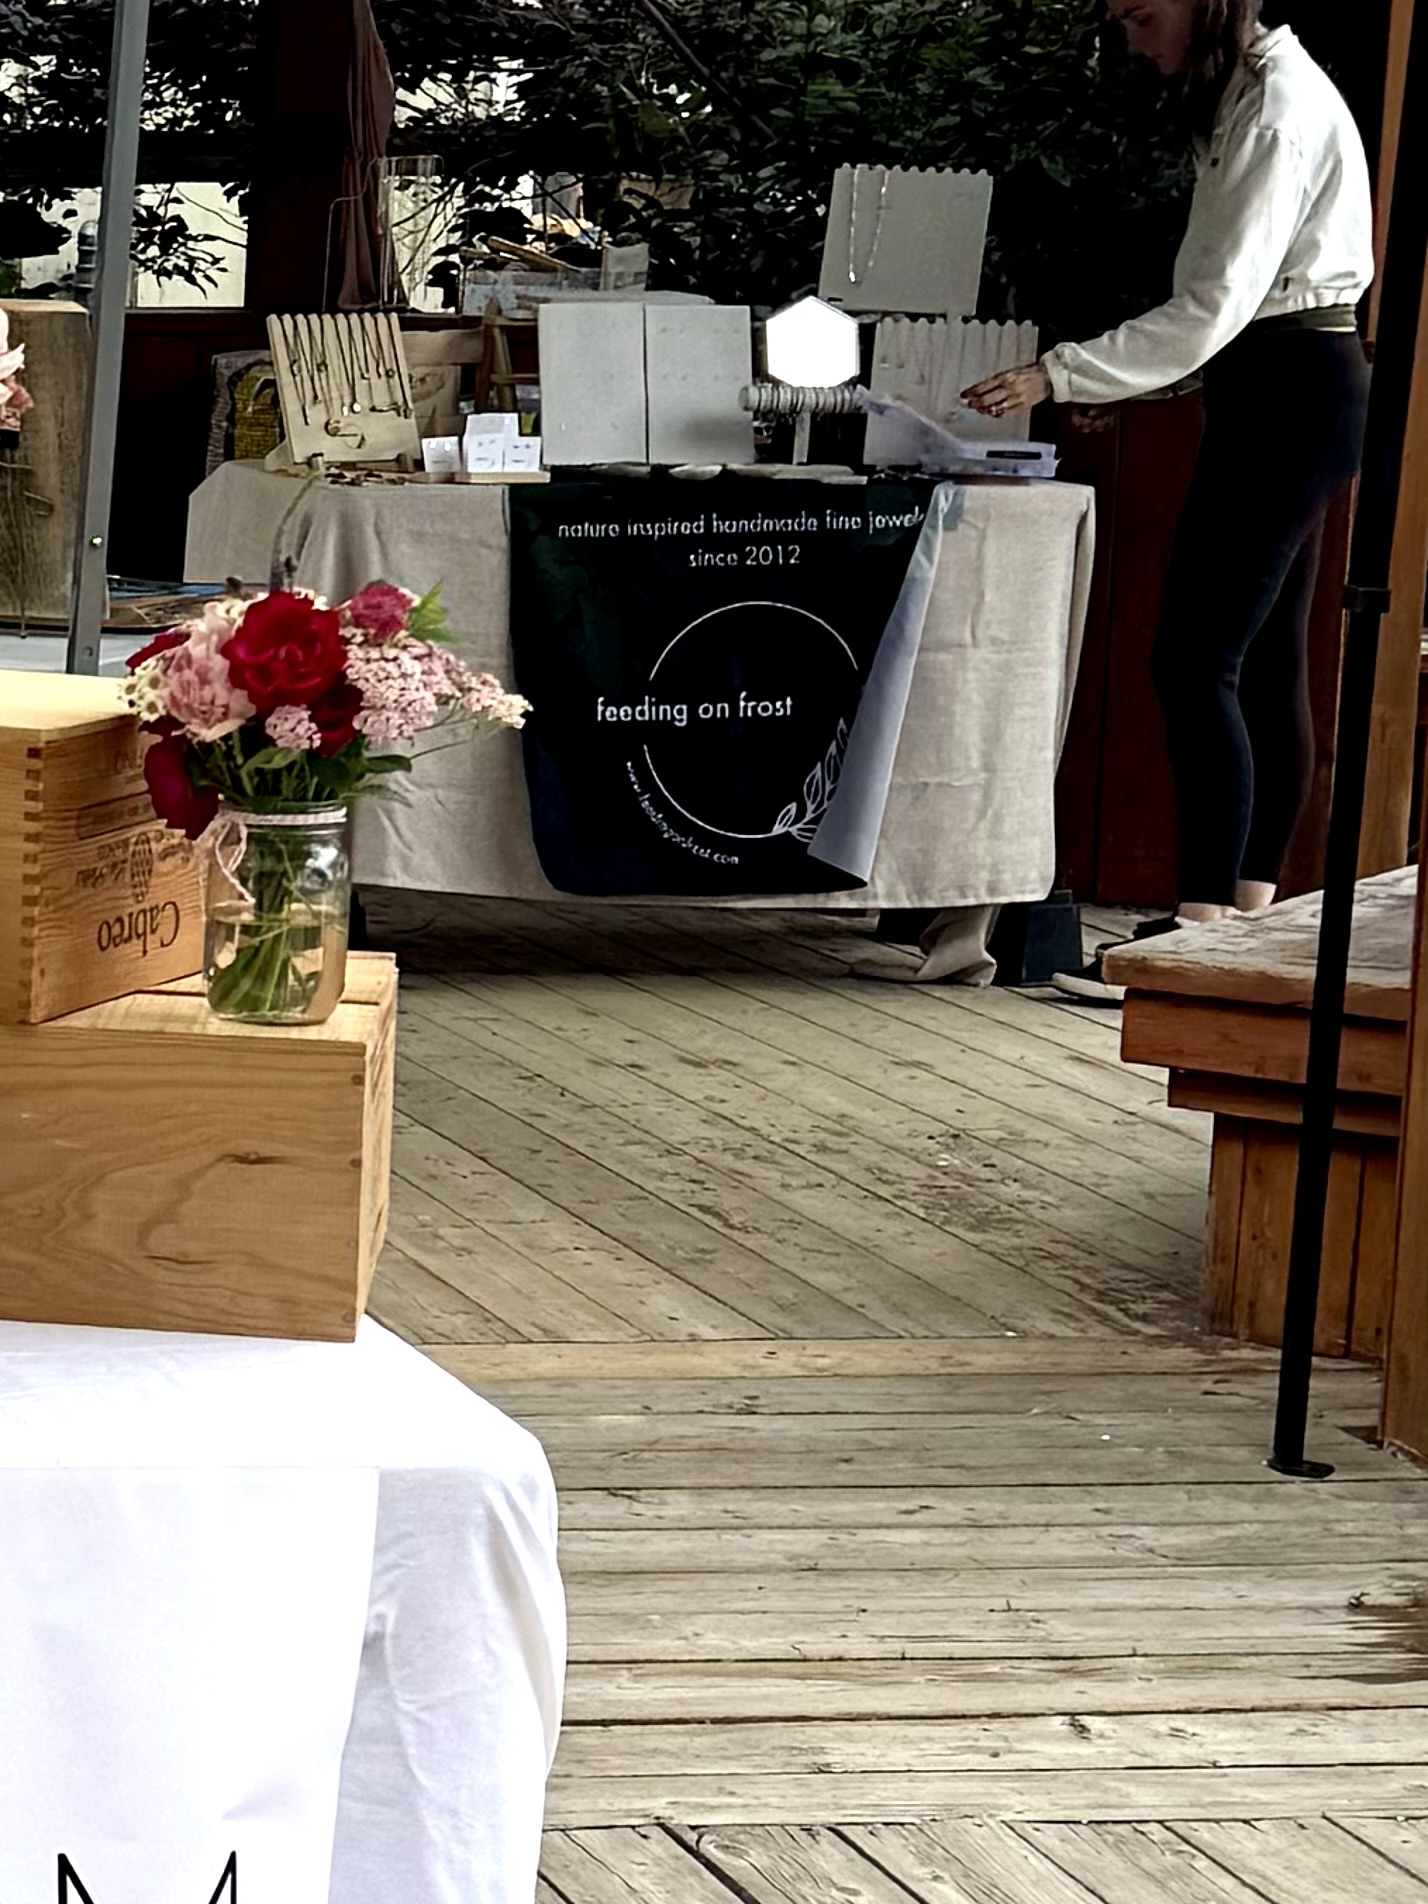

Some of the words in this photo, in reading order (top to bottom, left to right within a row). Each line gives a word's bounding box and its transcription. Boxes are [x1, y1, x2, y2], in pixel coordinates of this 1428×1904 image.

[559, 522, 619, 537] nature
[628, 515, 704, 540] inspired
[713, 511, 817, 532] handmade
[826, 510, 861, 529] fine
[690, 549, 737, 566] since
[746, 545, 800, 565] 2012
[597, 696, 687, 726] feeding
[698, 703, 729, 718] on
[739, 691, 792, 717] frost
[97, 900, 179, 957] Cabreo
